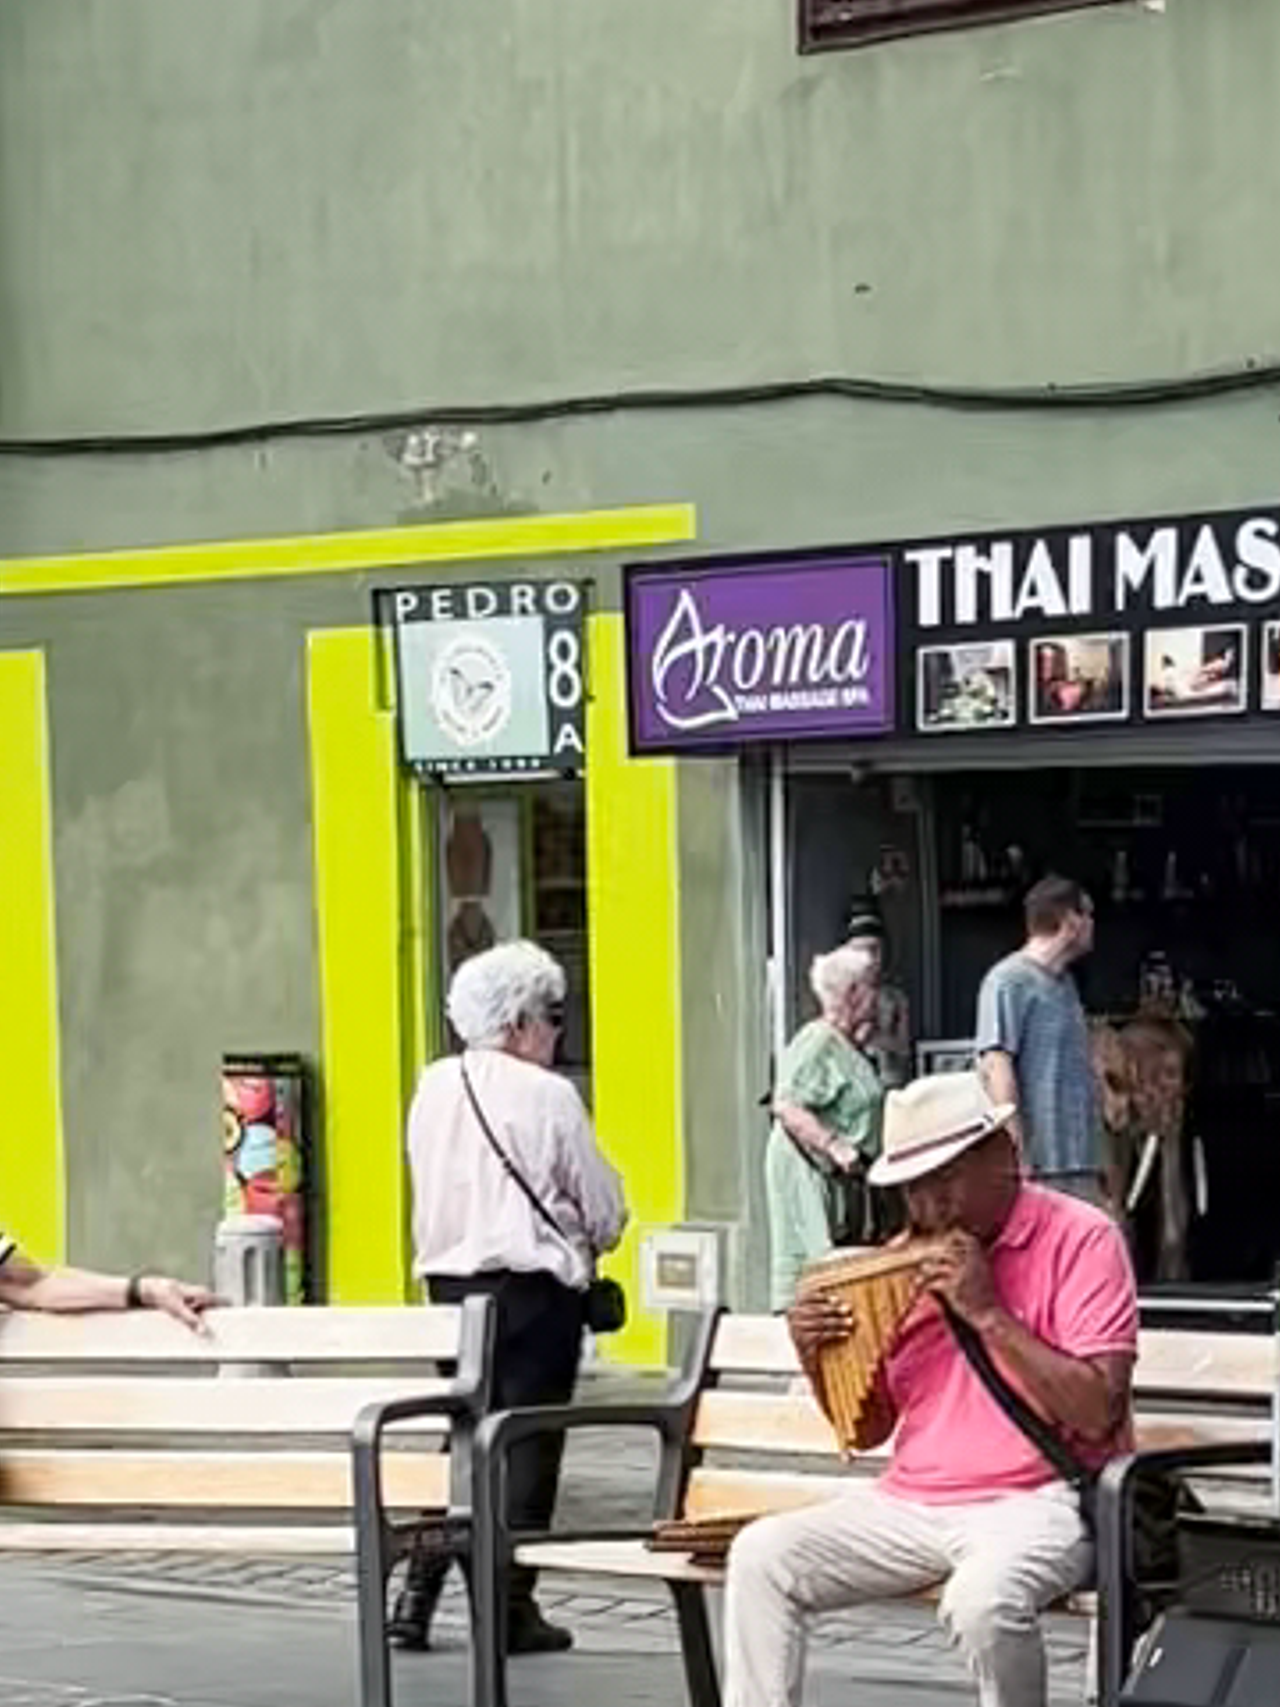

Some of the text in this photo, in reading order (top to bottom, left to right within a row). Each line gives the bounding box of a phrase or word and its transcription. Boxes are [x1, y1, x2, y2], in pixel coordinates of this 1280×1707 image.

[398, 583, 580, 622] PEDRO
[904, 533, 1092, 627] THAI
[652, 588, 870, 705] Aroma
